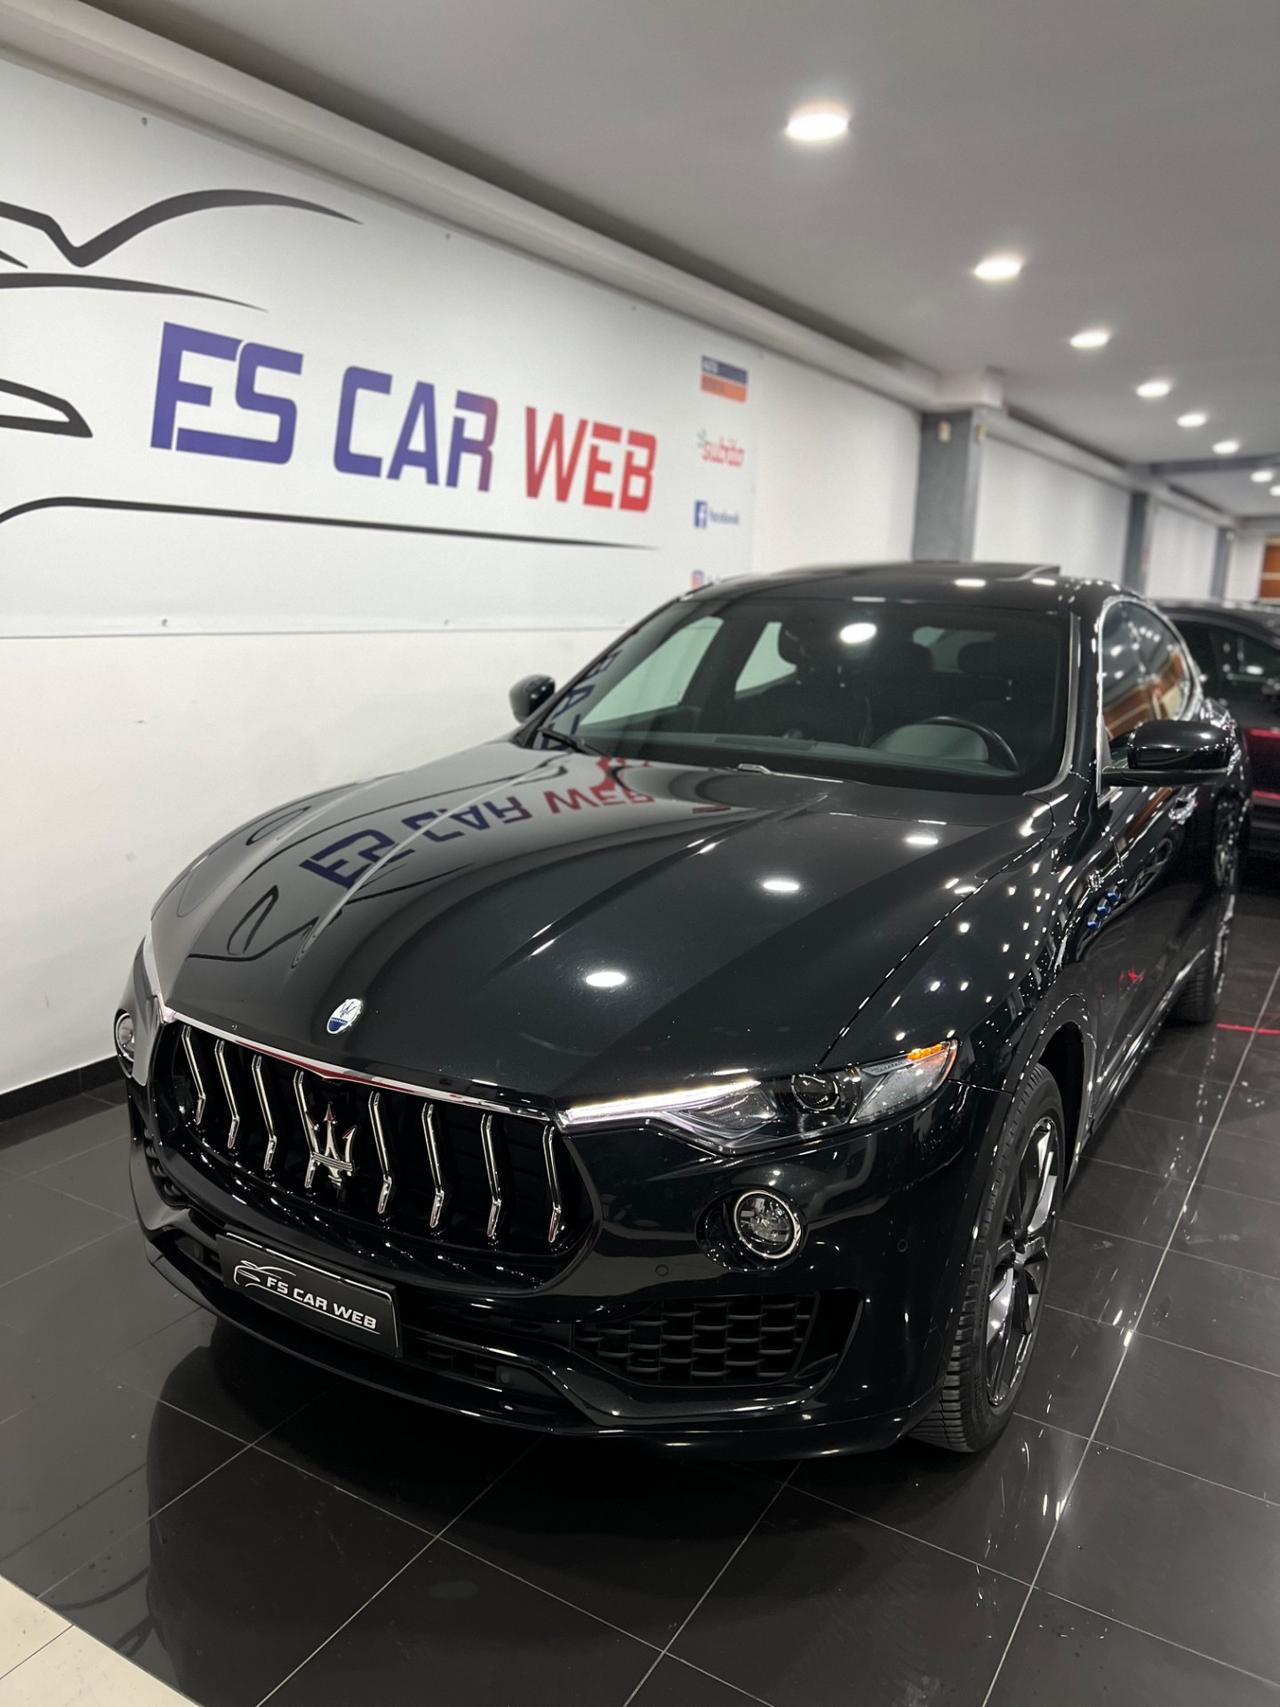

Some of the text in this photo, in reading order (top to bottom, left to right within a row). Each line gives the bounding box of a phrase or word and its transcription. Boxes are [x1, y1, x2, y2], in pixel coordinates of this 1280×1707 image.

[333, 366, 498, 492] CAR
[525, 406, 657, 513] WEB
[266, 1276, 377, 1330] FS CAR WEB
